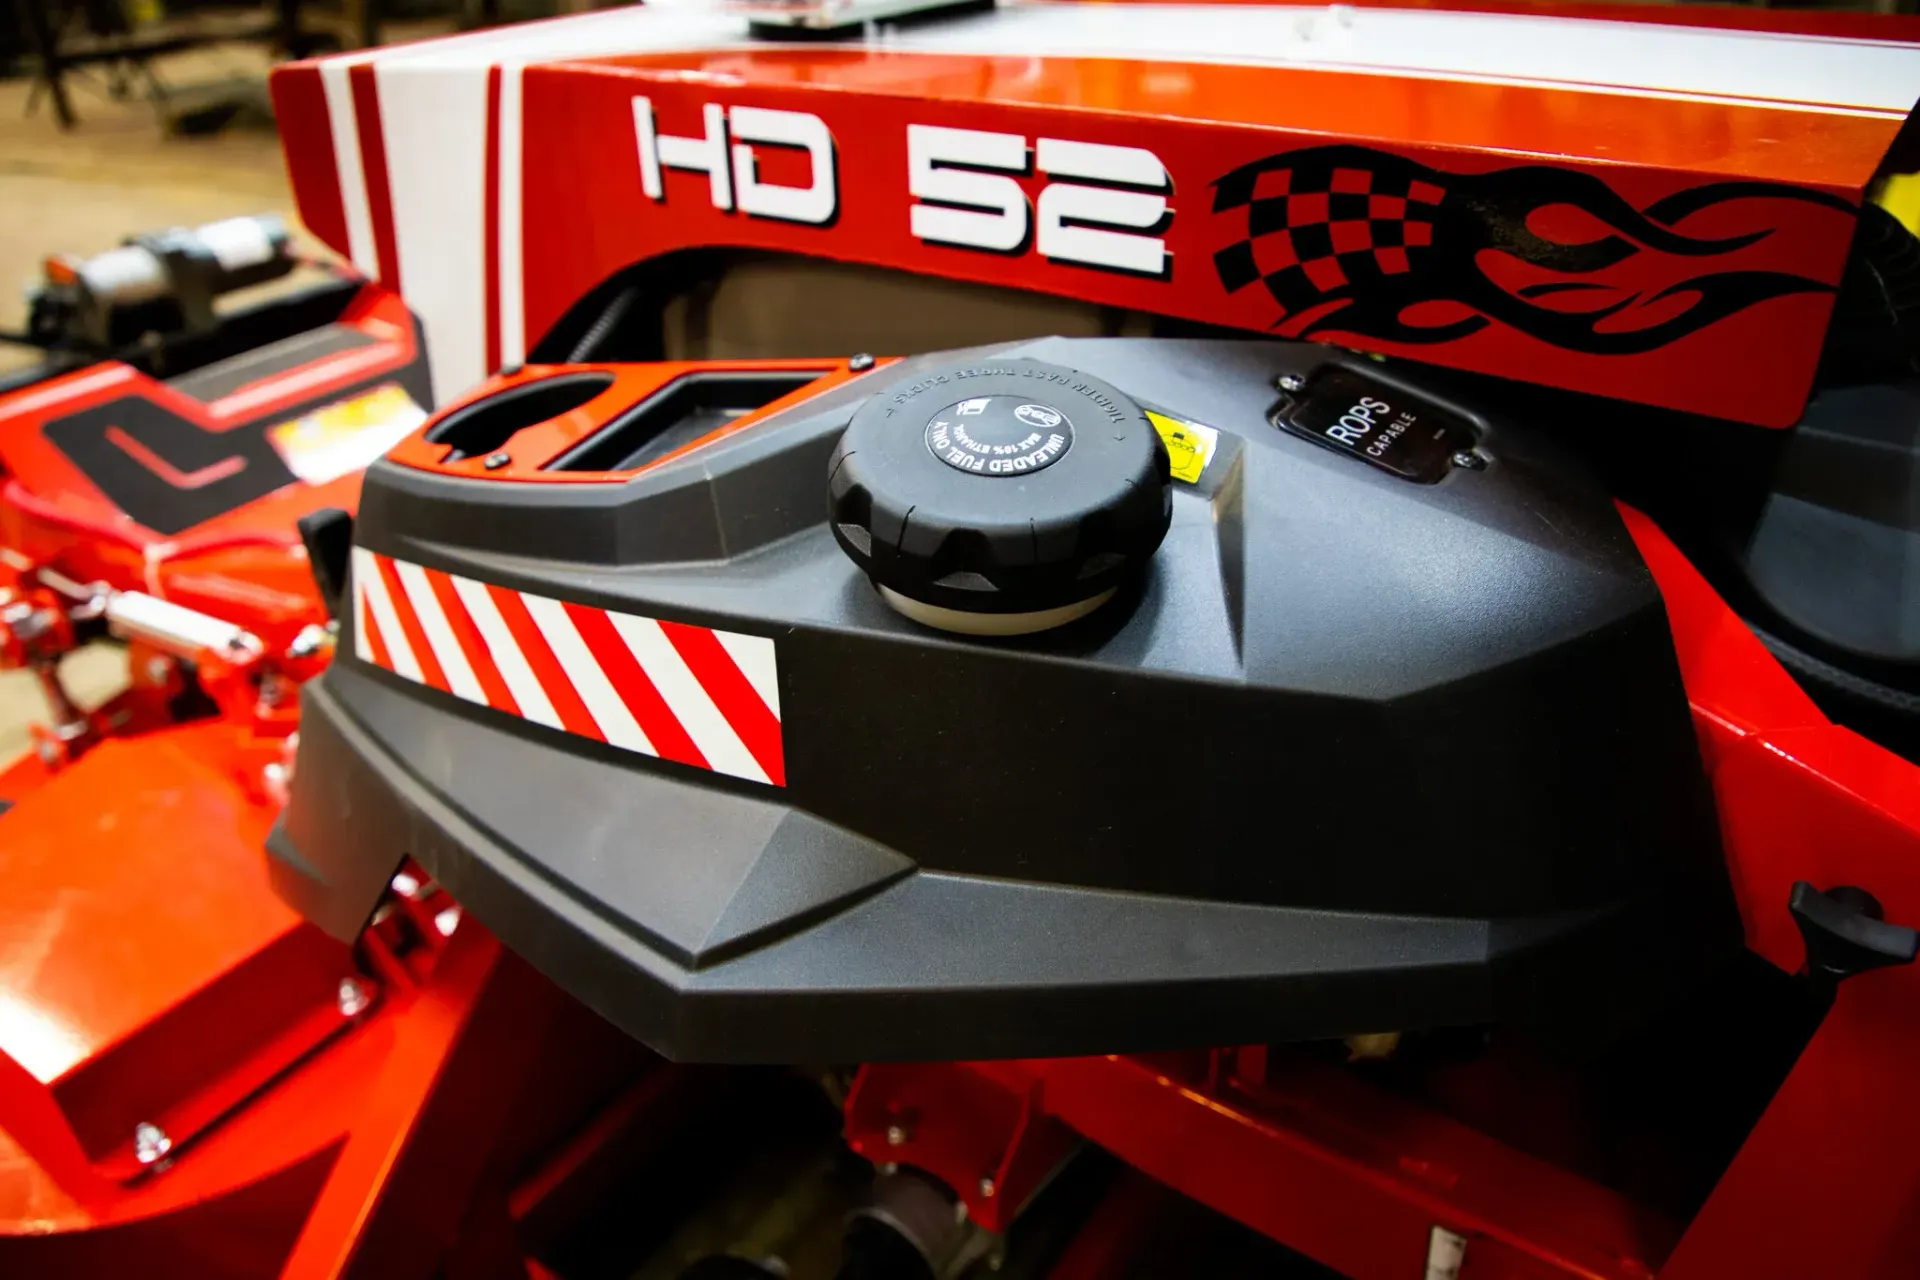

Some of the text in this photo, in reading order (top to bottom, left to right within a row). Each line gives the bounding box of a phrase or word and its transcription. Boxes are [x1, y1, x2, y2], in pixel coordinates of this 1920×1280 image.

[631, 95, 1172, 280] HD 52
[893, 367, 1127, 424] TIGHTEN PAST THREE CLICKS
[953, 423, 1042, 455] MAX 10% ETHANOL
[1325, 396, 1391, 446] ROPS
[1366, 411, 1417, 457] CAPABLE
[932, 421, 1065, 472] UNLEADED FUEL ONLY
